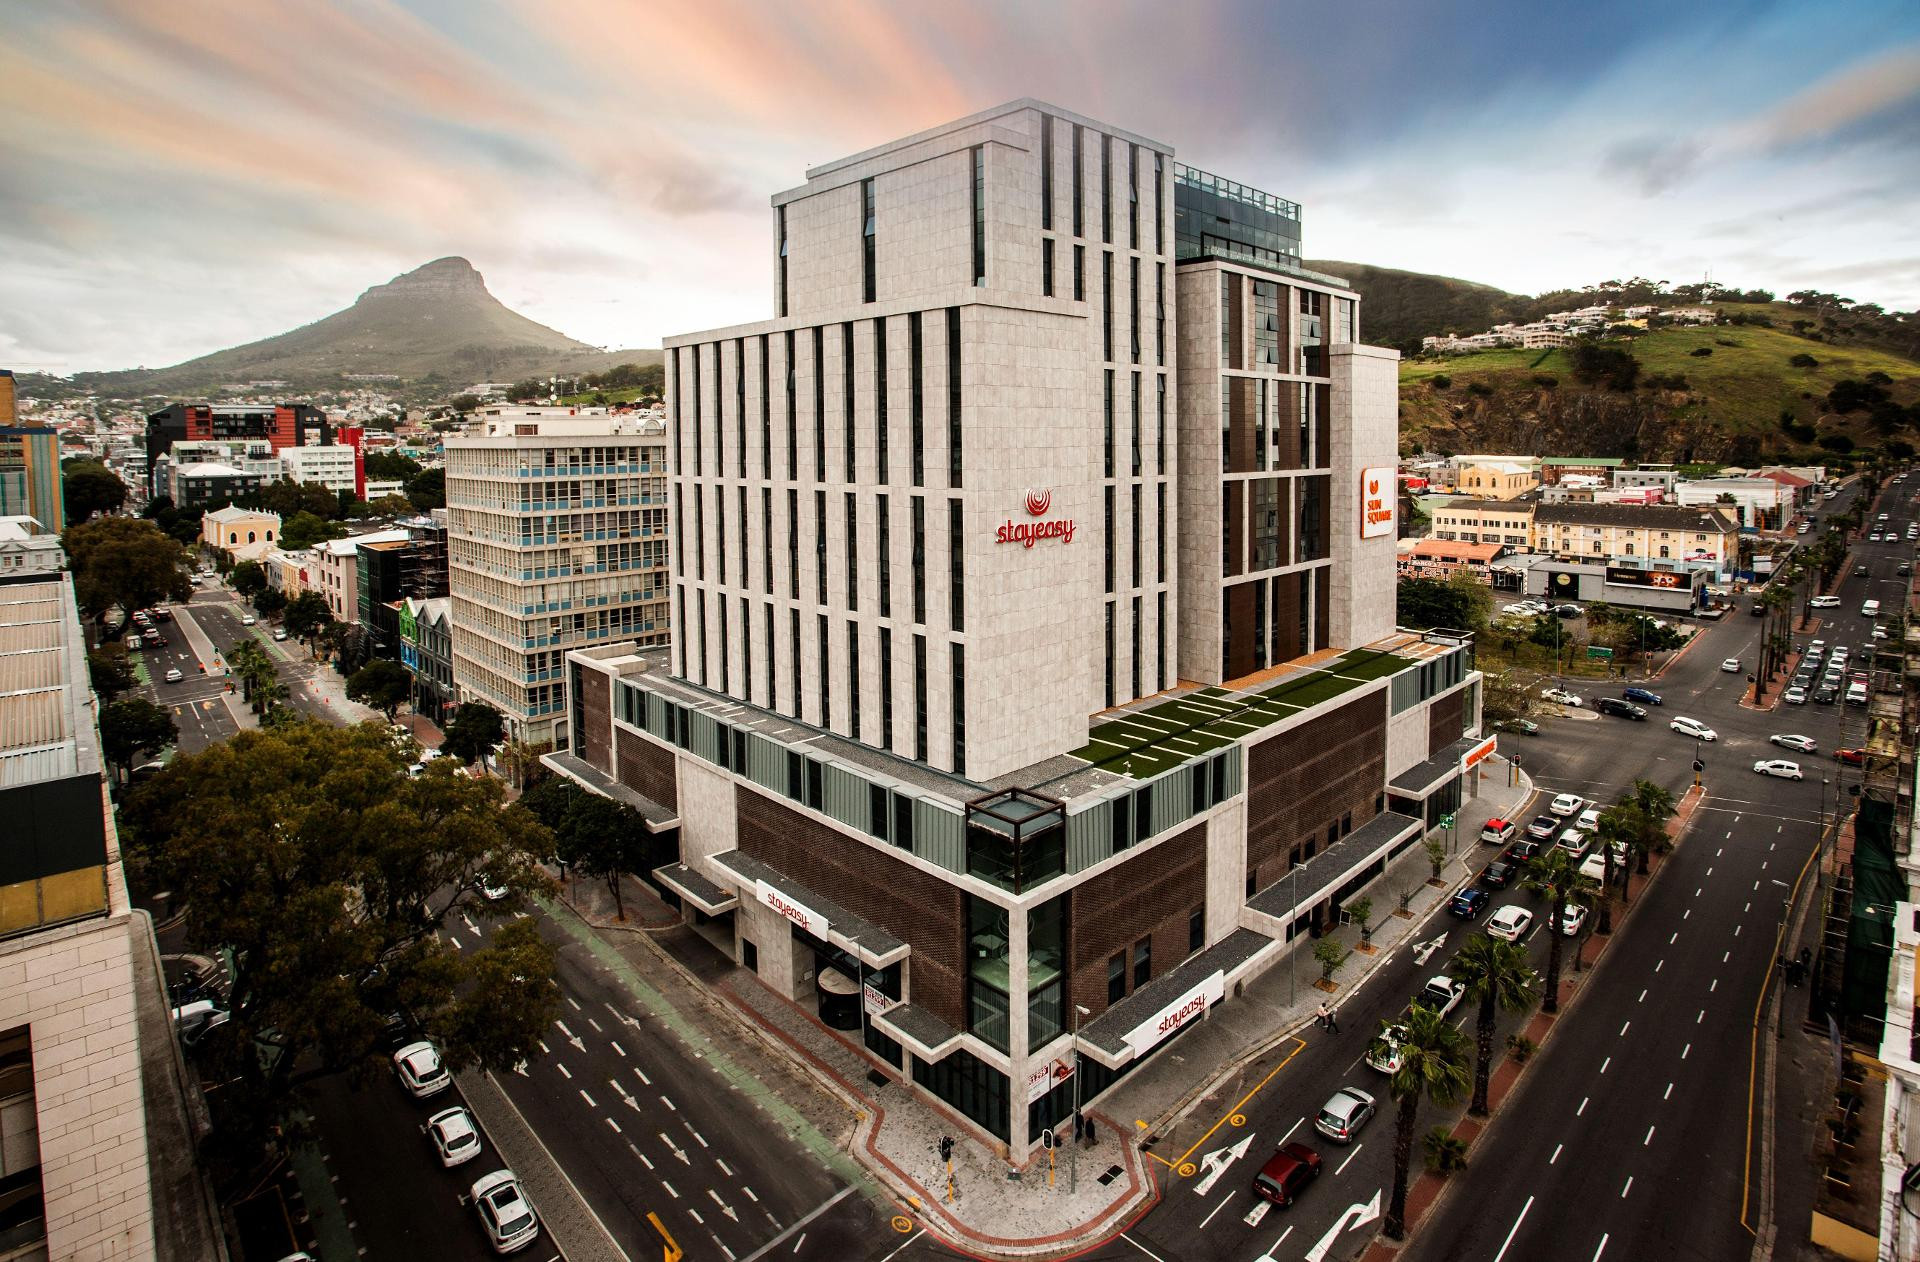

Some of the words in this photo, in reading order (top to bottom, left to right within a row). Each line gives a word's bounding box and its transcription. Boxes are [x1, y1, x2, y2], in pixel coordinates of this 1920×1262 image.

[1367, 499, 1382, 512] SUN
[1367, 510, 1393, 525] SQUARE
[995, 519, 1076, 549] stayeasy
[767, 892, 812, 930] stayeasy
[1156, 993, 1207, 1036] stayeasy
